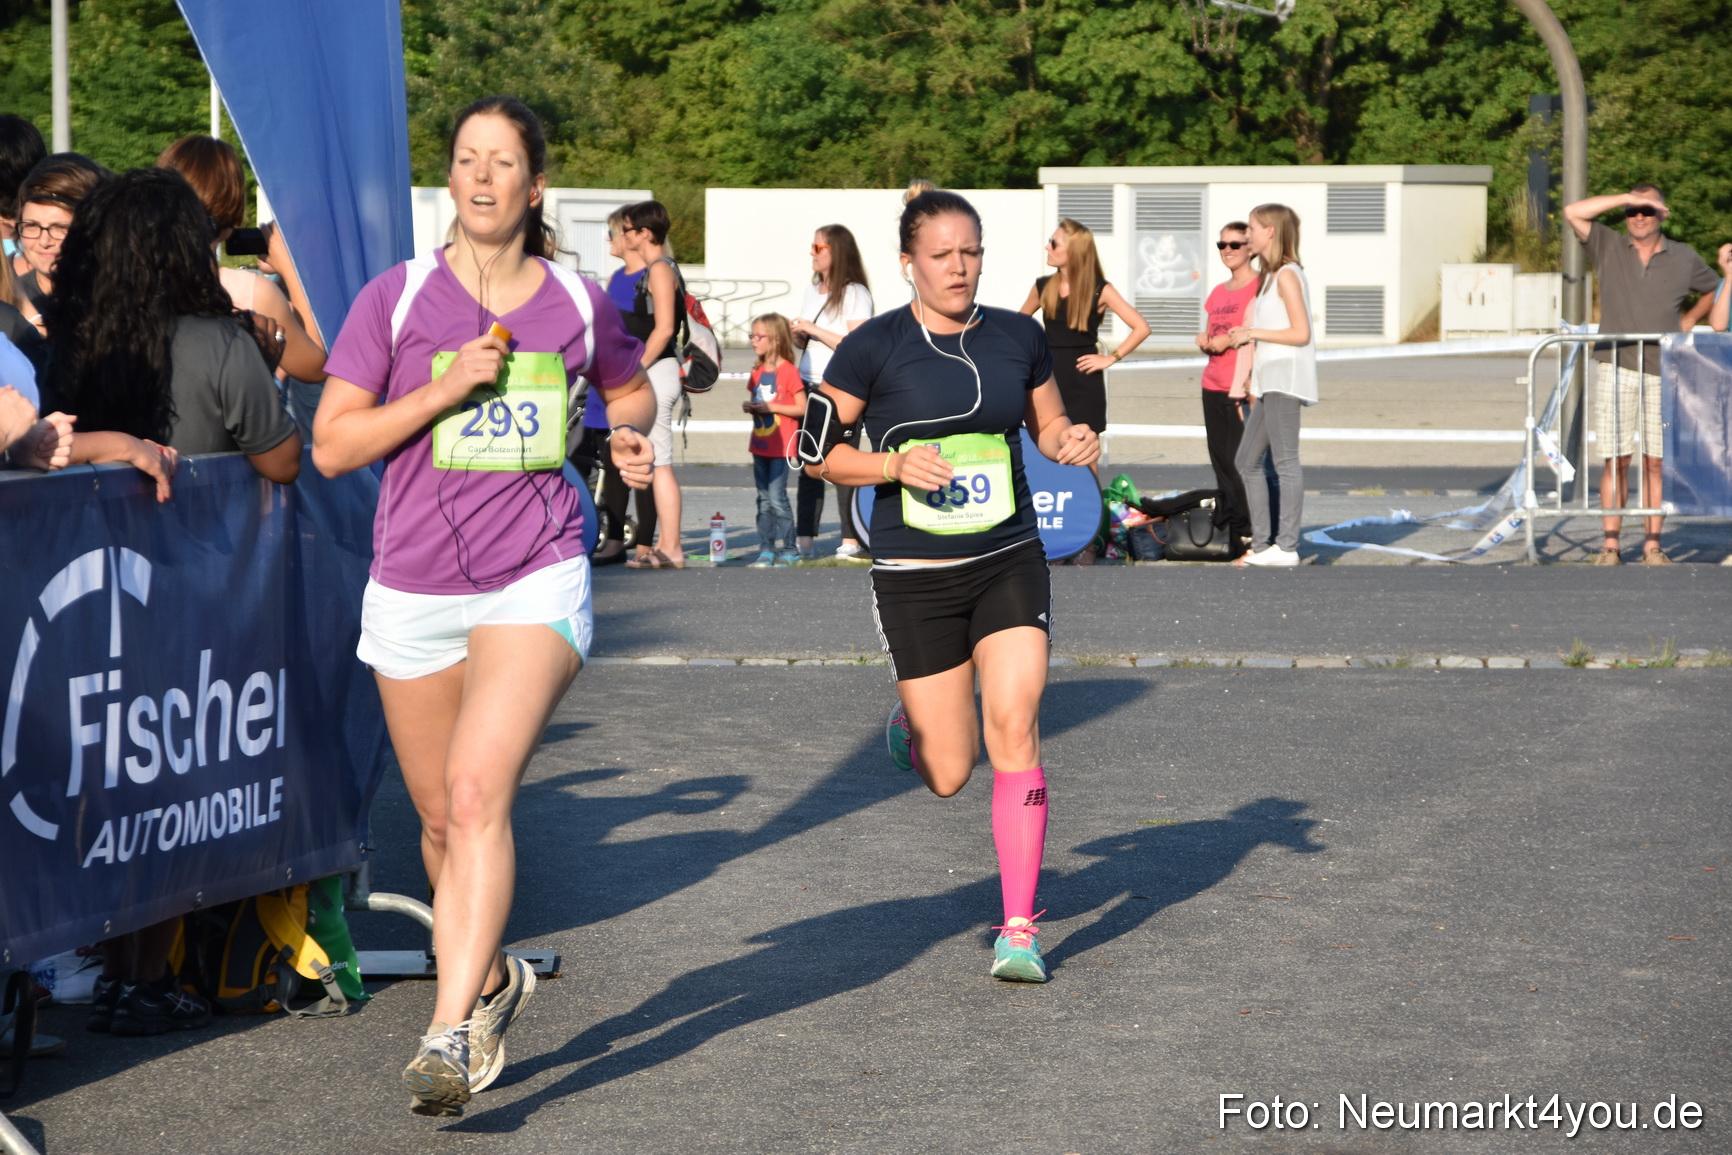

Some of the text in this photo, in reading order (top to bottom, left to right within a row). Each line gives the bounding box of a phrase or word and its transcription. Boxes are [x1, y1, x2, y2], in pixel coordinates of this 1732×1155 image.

[459, 400, 540, 438] 293
[488, 445, 533, 454] Botzenhrt
[925, 472, 992, 508] 859
[82, 776, 284, 868] AUTOMOBILE
